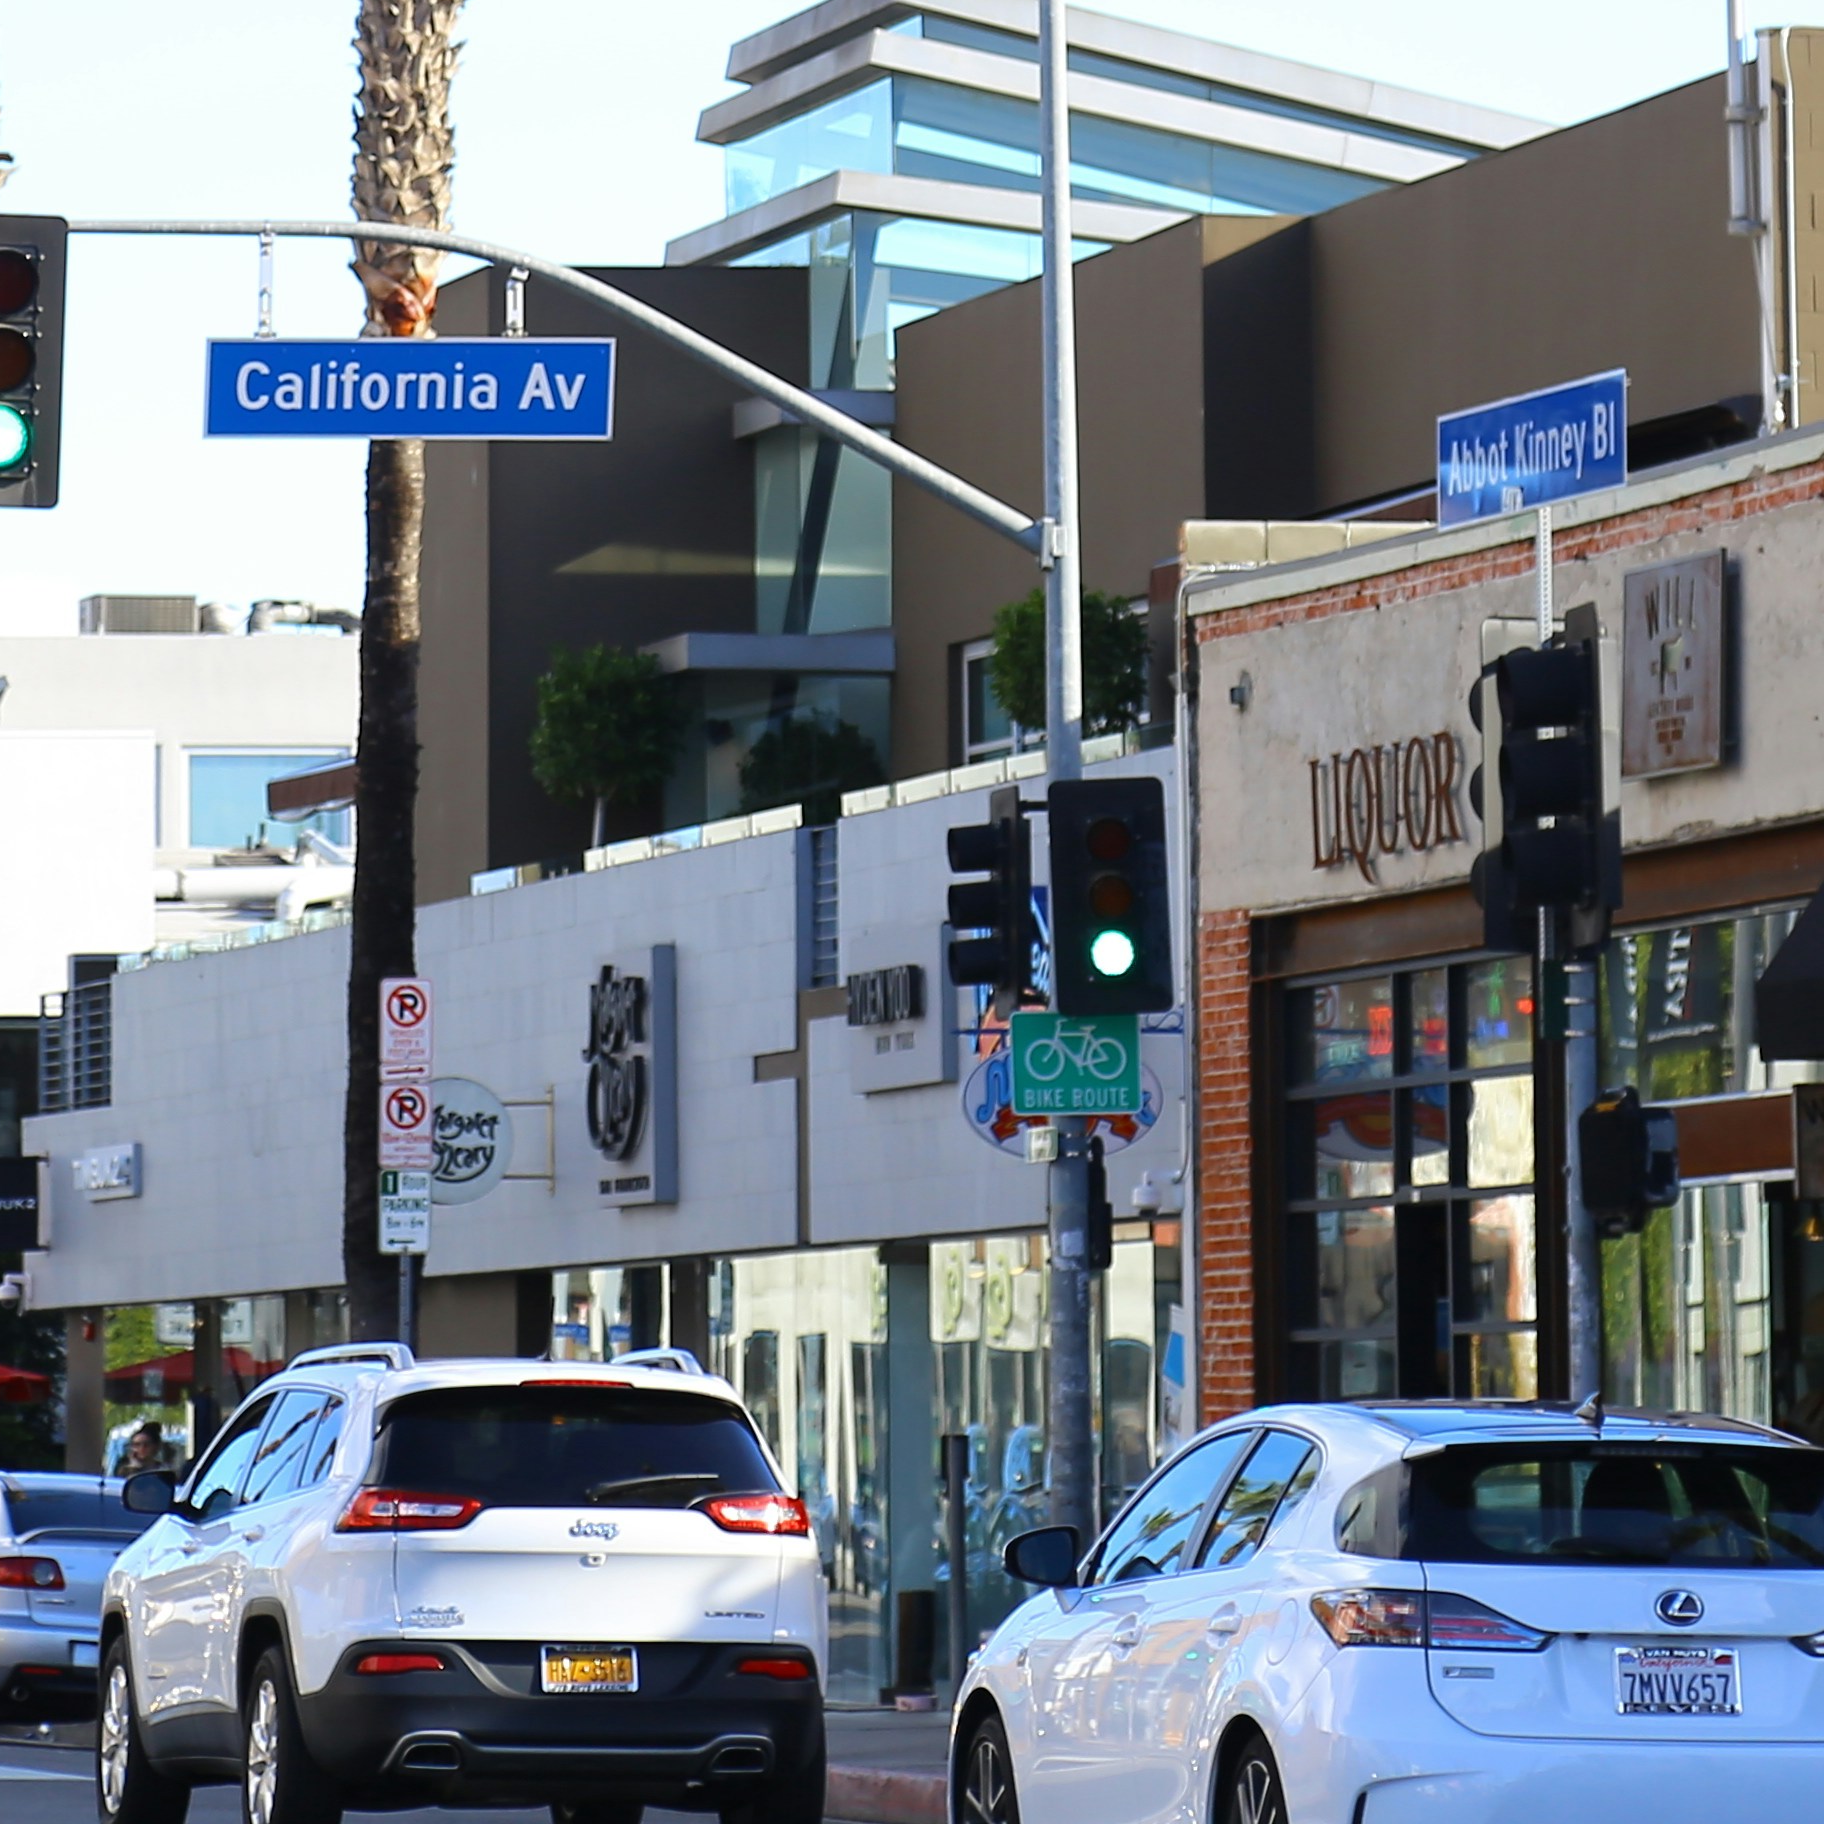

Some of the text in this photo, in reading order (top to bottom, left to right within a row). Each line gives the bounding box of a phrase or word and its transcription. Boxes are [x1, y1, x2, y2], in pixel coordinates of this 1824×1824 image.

[235, 360, 588, 411] California Av
[1448, 400, 1616, 497] Abbot Kinney Bl
[1308, 730, 1463, 886] LIQUOR
[1024, 1086, 1130, 1109] BIKE ROUTE
[432, 1104, 500, 1141] argaret
[568, 1518, 621, 1540] Jeep
[704, 1609, 766, 1620] LIMITED
[1645, 1649, 1670, 1658] VAN
[1623, 1672, 1732, 1705] 7MVV657
